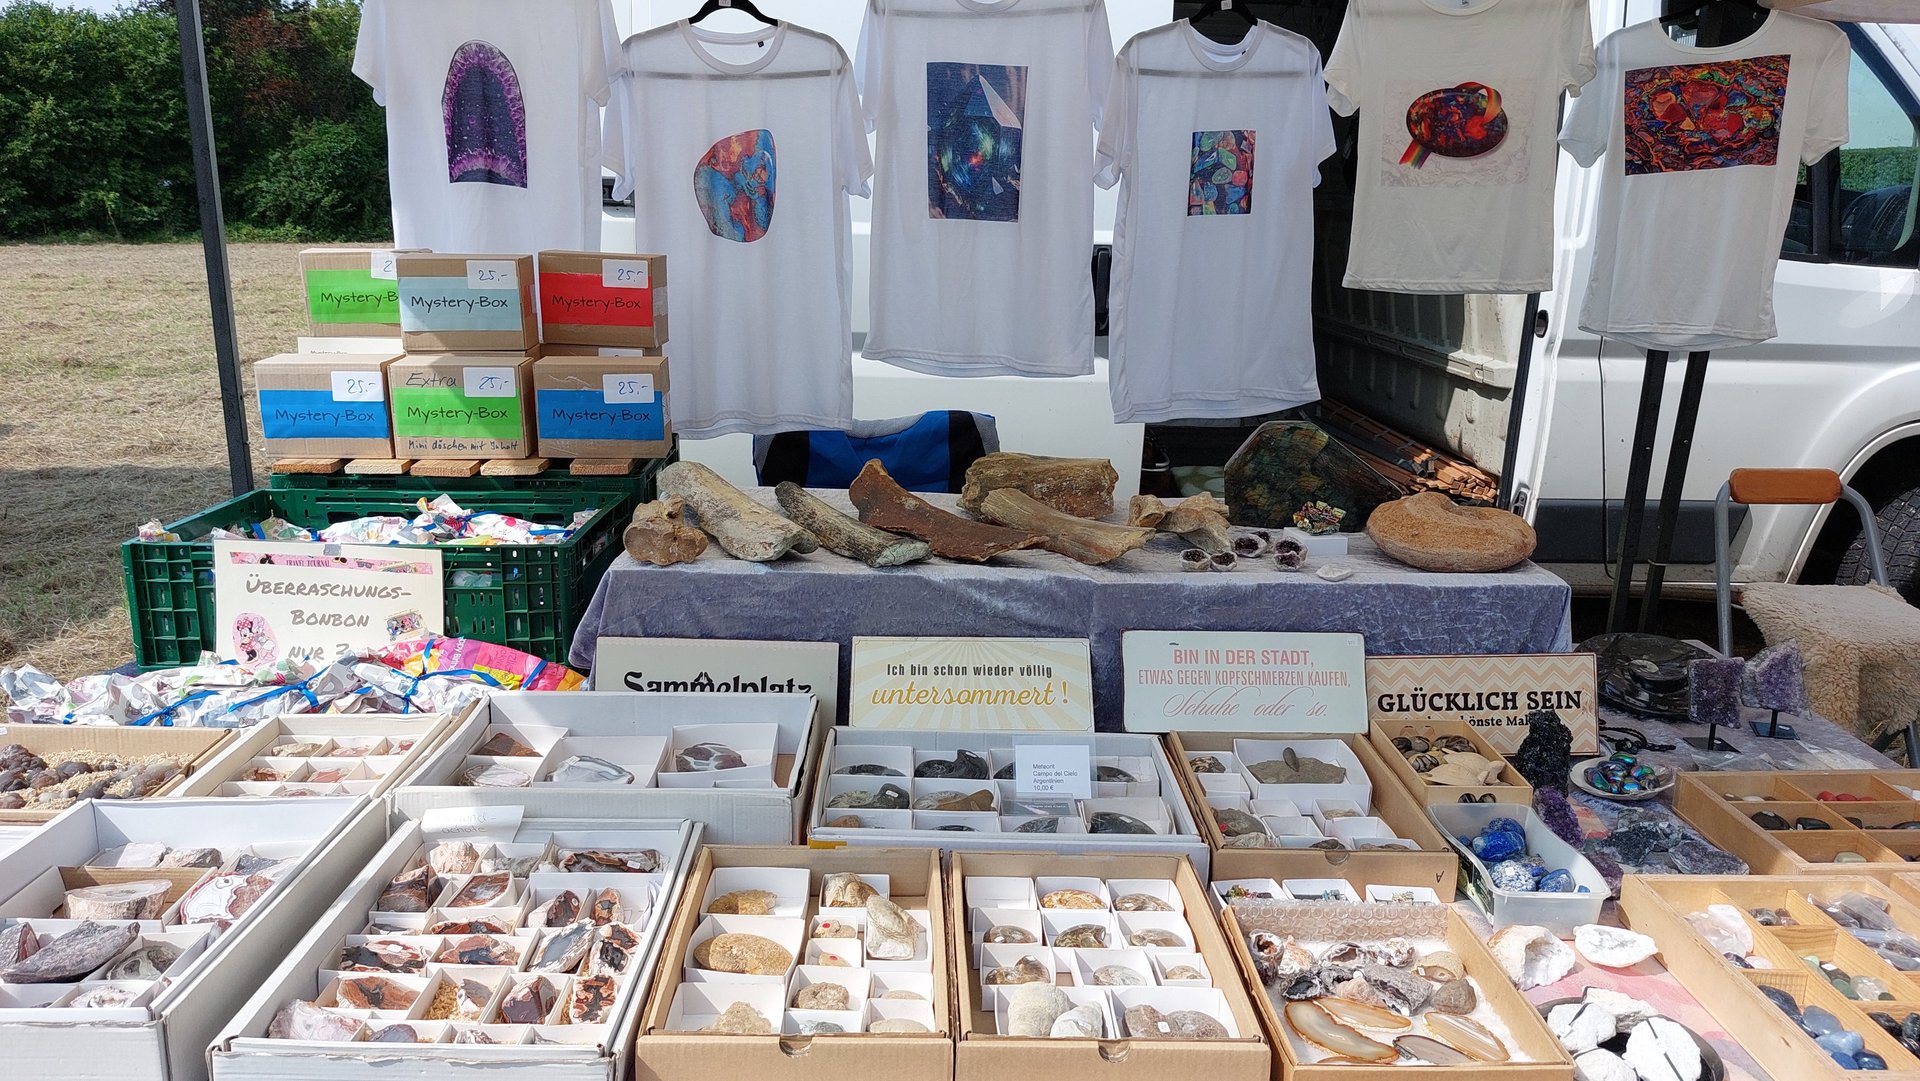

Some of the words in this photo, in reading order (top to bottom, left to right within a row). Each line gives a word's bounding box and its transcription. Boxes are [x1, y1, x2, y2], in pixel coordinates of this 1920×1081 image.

[383, 260, 393, 273] 2
[320, 291, 399, 309] Mystery-B
[411, 295, 508, 314] Mystery-Box
[552, 294, 641, 312] Mystery-Box
[405, 372, 457, 388] Extra
[275, 409, 375, 427] Mystery-Box
[407, 406, 508, 424] Mystery-Box
[552, 408, 651, 426] Mystery-Box
[408, 440, 428, 450] Mini
[470, 441, 487, 451] mit
[246, 573, 412, 599] ÜBERRASCHUNGS-
[290, 608, 370, 628] BONBON
[1173, 649, 1199, 664] BIN
[1204, 649, 1220, 664] IN
[1225, 650, 1256, 665] DER
[1261, 650, 1315, 667] STADT,
[887, 663, 905, 676] Ich
[910, 663, 928, 676] bin
[933, 664, 968, 676] schon
[973, 664, 1014, 677] wieder
[1019, 664, 1052, 679] völlig
[1138, 669, 1173, 685] ETWAS
[1177, 670, 1211, 685] GEGEN
[1215, 670, 1304, 686] KOPFSCHMERZEN
[1307, 671, 1351, 687] KAUFEN,
[871, 680, 1057, 706] untersommert
[1163, 686, 1259, 717] Schuhe
[1253, 687, 1313, 717] oder
[1306, 701, 1328, 717] so.
[1377, 687, 1519, 712] GLÜCKLICH
[1526, 690, 1583, 710] SEIN
[1459, 715, 1503, 727] önste
